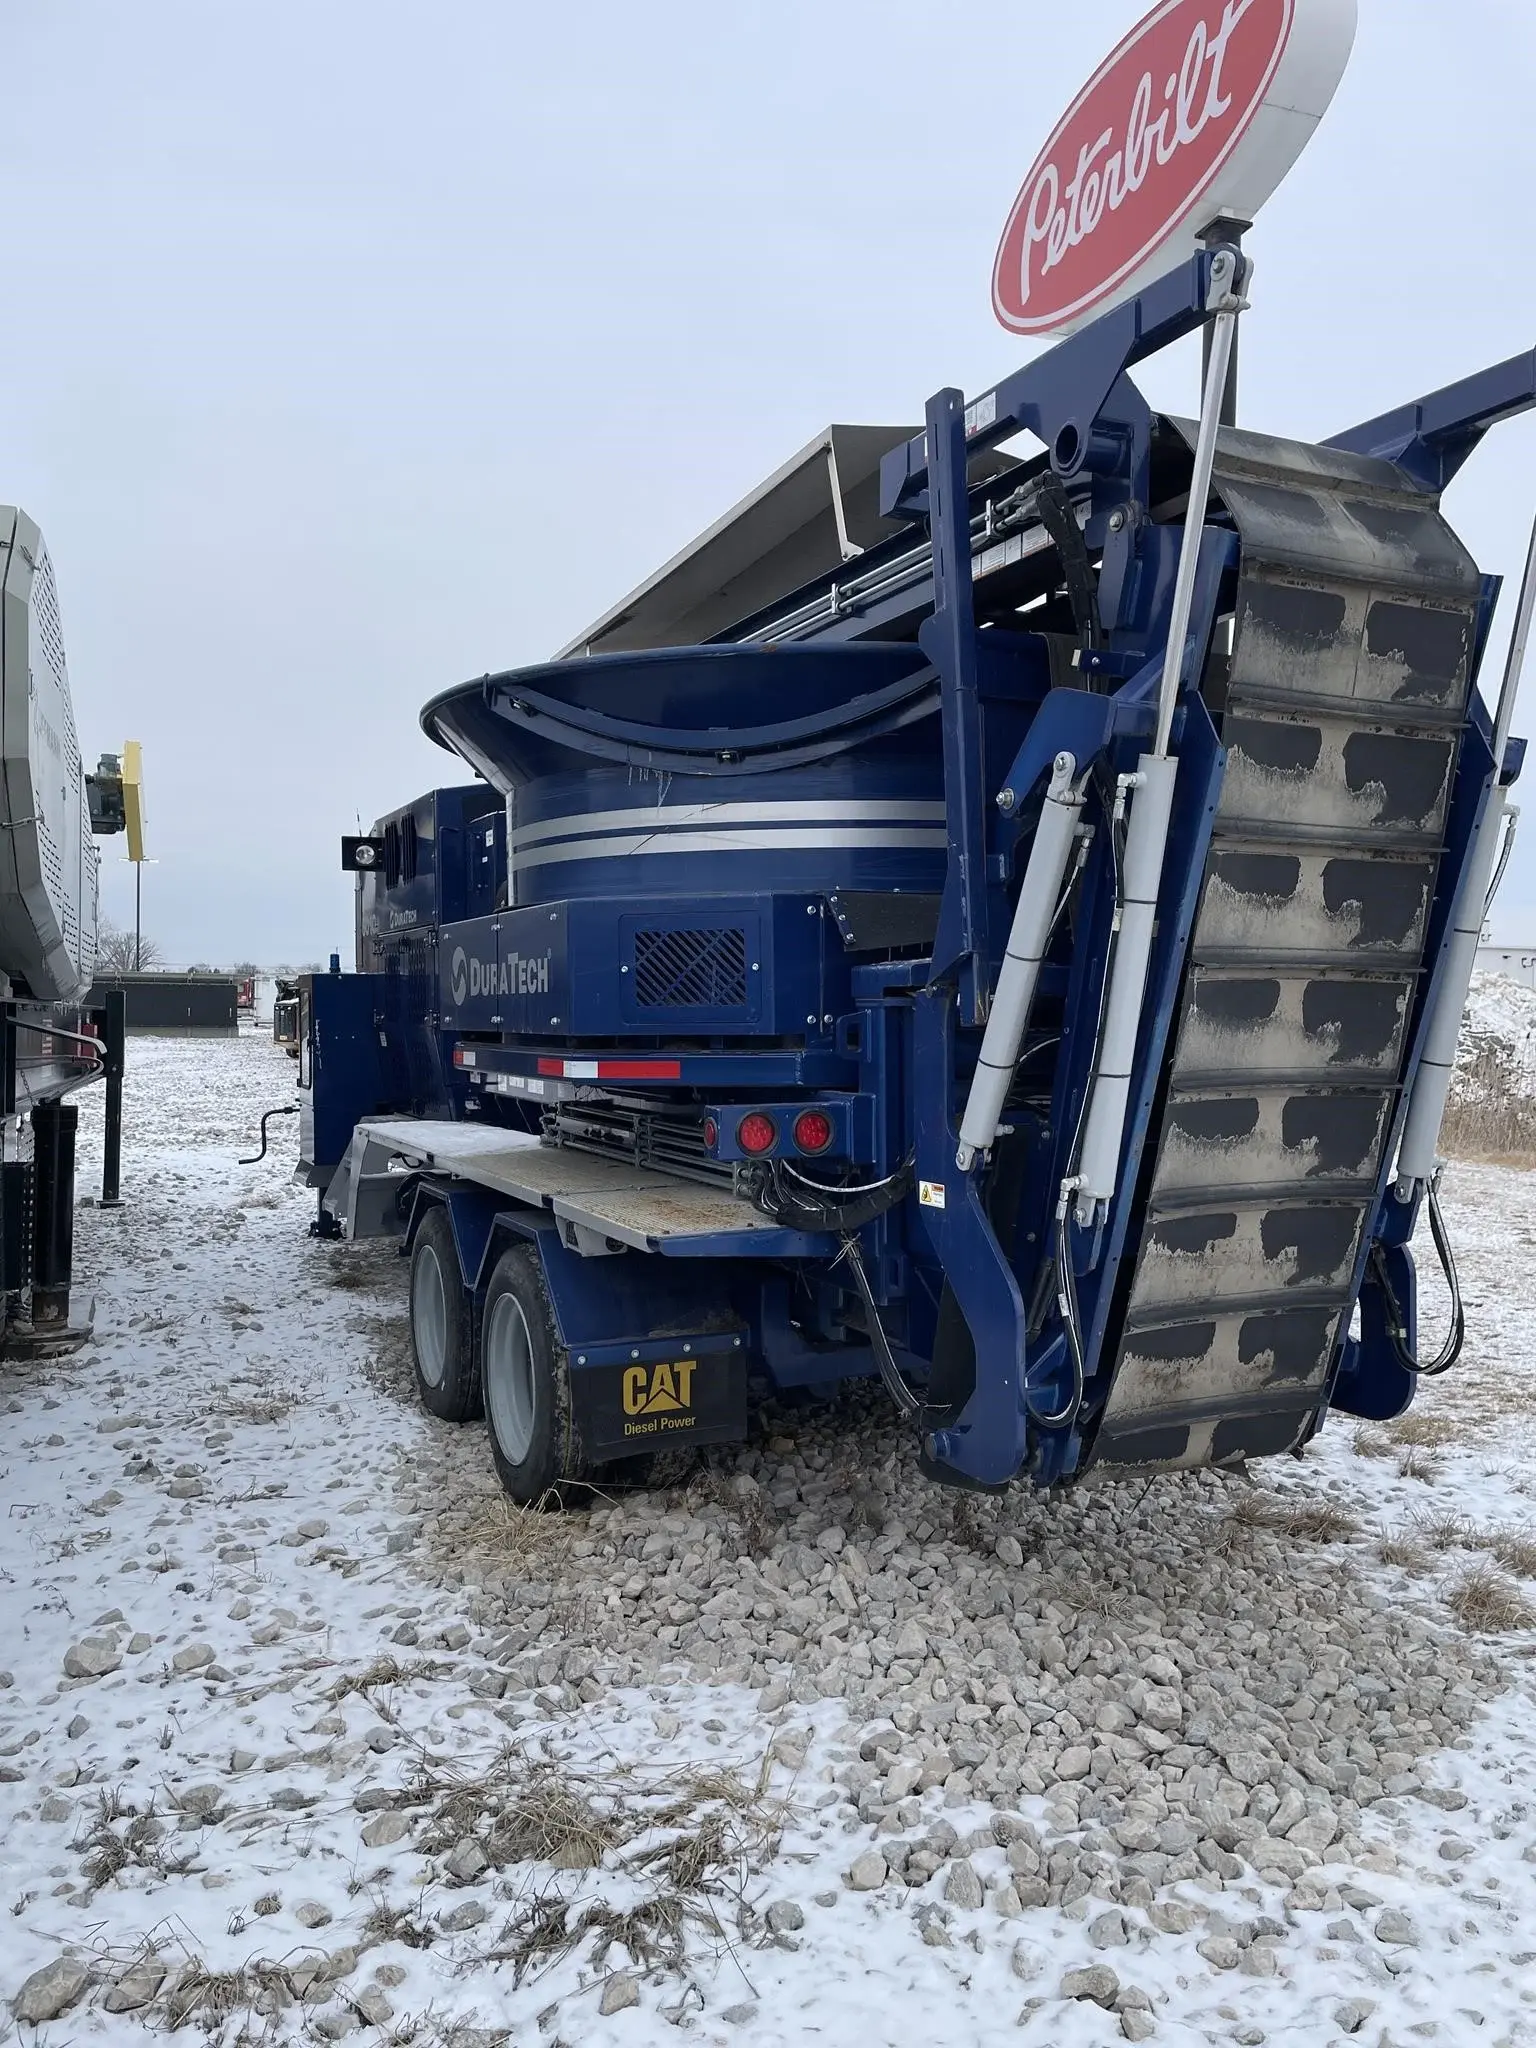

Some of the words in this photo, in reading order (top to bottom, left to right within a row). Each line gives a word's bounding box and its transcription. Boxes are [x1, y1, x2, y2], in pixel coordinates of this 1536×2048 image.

[1020, 0, 1253, 305] Peterbilt
[622, 1360, 697, 1416] CAT
[624, 1419, 657, 1436] Diesel
[660, 1416, 696, 1430] Power
